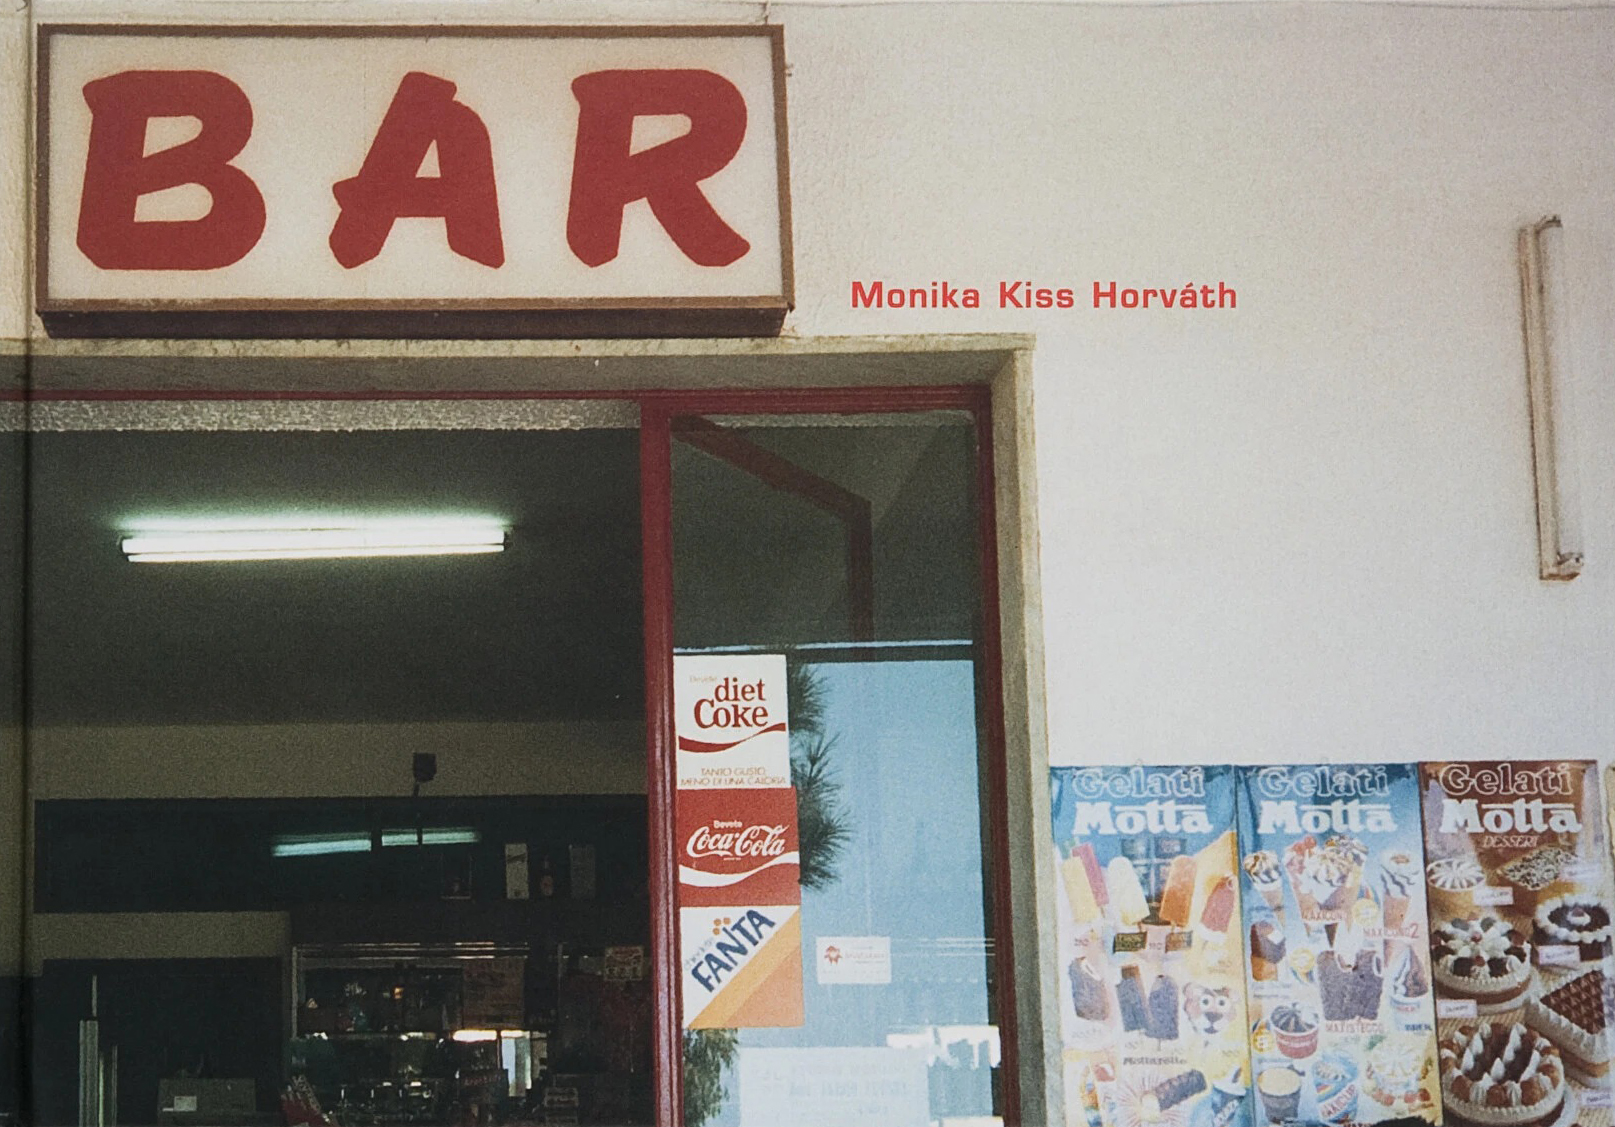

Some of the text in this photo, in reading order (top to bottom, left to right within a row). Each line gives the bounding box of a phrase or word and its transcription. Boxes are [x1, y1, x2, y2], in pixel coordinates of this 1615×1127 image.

[76, 68, 751, 271] BAR
[714, 676, 767, 702] diet
[694, 698, 769, 729] Coke
[1072, 766, 1206, 799] Gelati
[1258, 765, 1391, 798] Gelati
[1439, 763, 1574, 796] Gelati
[1071, 799, 1214, 835] Motta
[1256, 798, 1399, 834] Motta
[1439, 797, 1583, 834] Motta
[686, 824, 791, 858] Coca-Cola
[1482, 835, 1541, 848] DESSERT
[691, 909, 776, 993] FANTA
